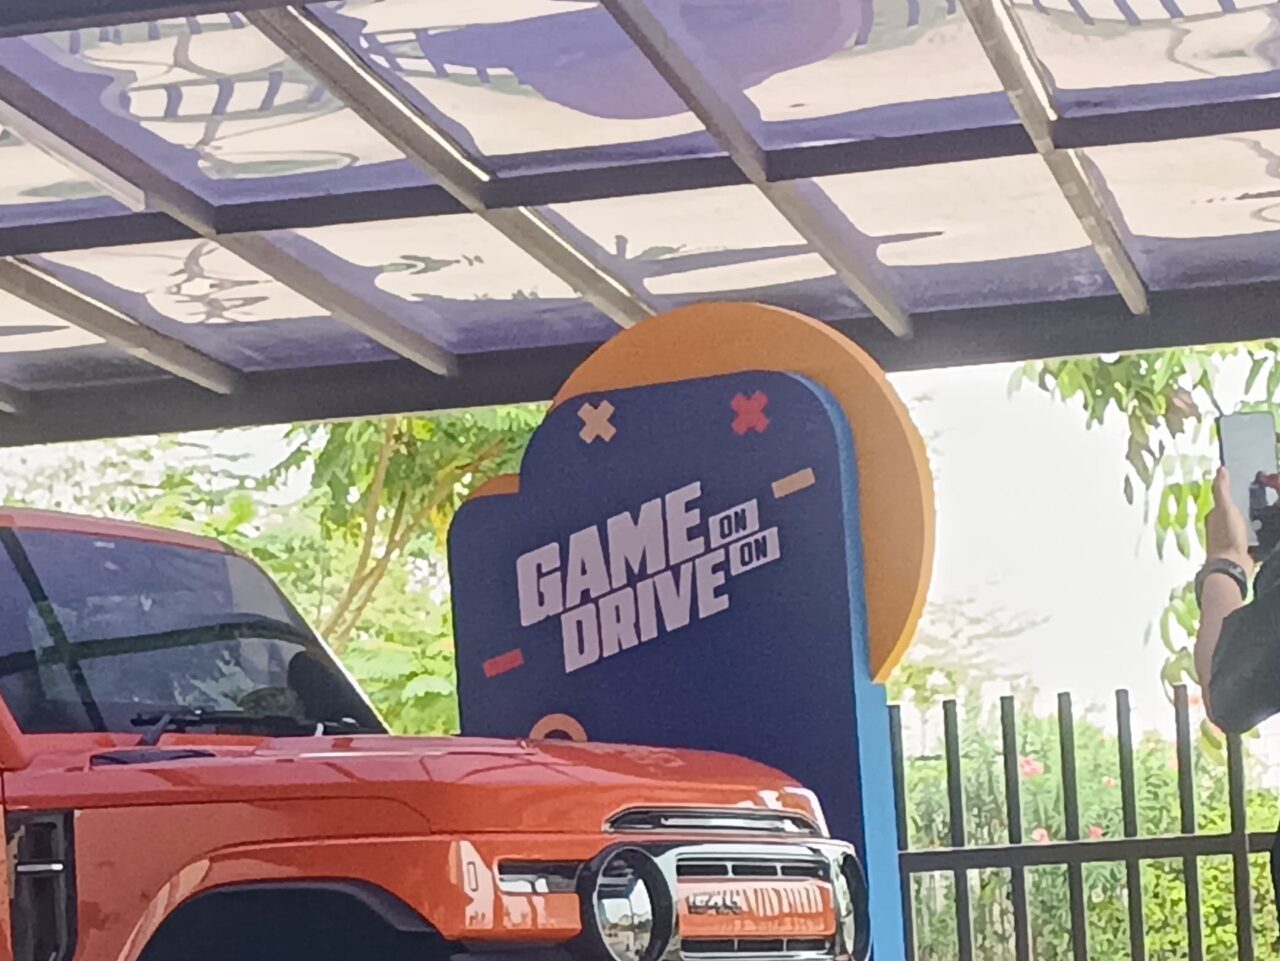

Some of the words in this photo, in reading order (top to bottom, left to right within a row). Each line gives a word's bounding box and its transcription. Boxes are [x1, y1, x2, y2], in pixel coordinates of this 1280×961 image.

[516, 481, 704, 627] GAME
[719, 509, 748, 540] ON
[561, 548, 730, 673] DRIVE
[739, 536, 768, 566] ON
